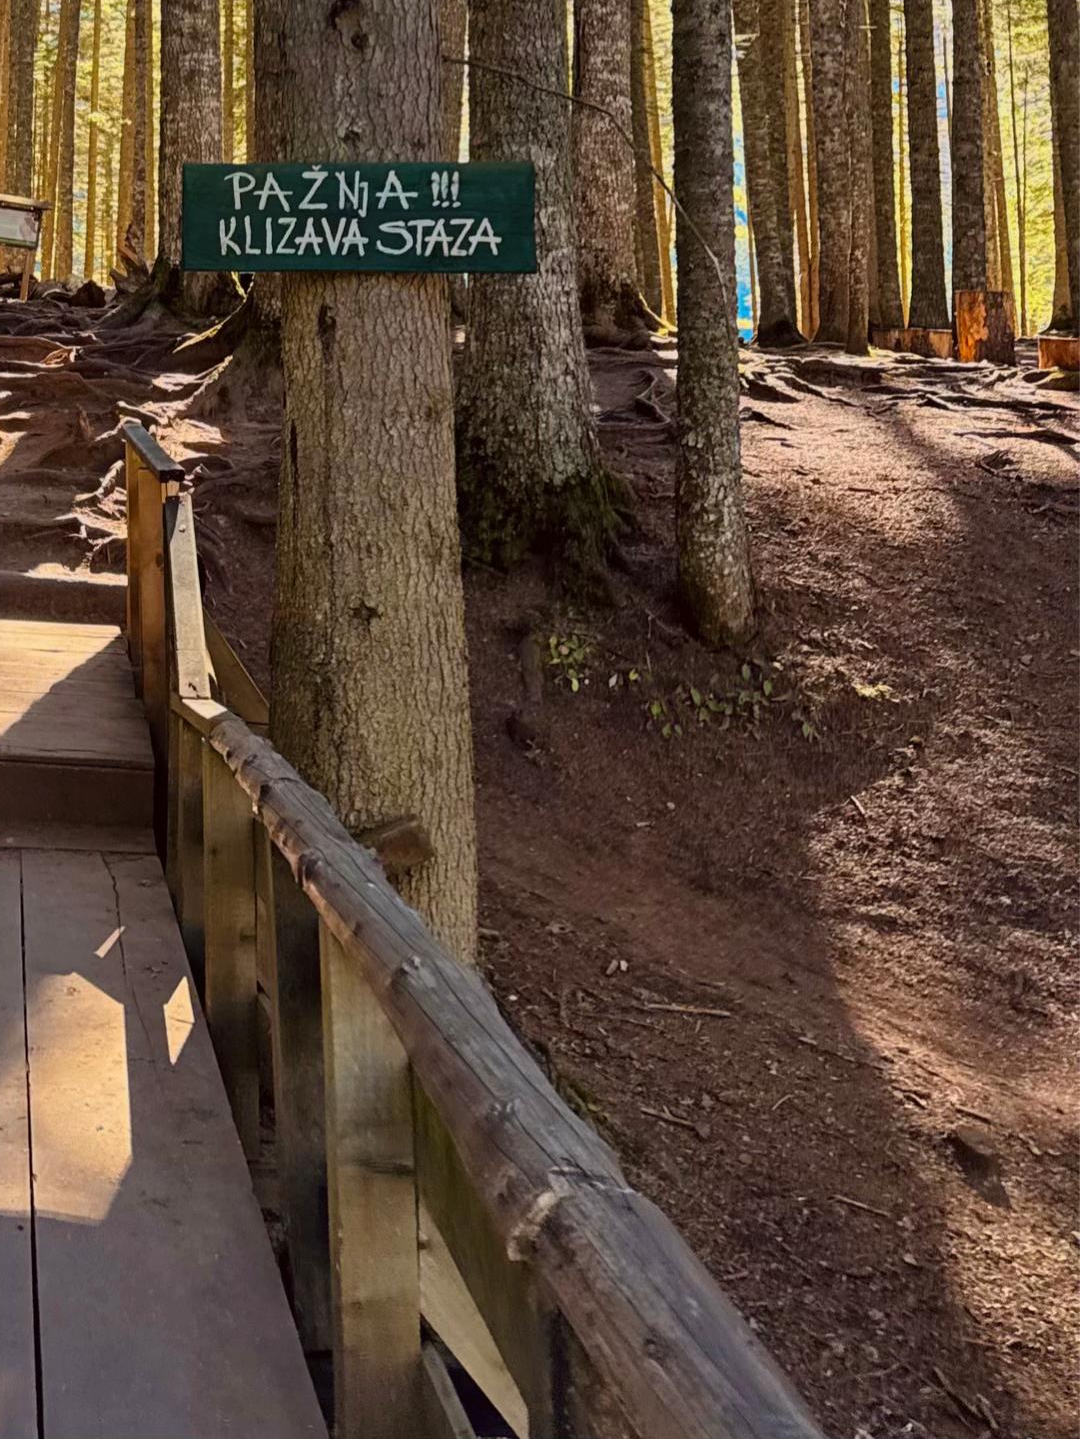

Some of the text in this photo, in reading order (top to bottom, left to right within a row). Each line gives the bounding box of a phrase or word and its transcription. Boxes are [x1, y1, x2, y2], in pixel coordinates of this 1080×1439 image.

[430, 170, 462, 209] !!!
[219, 215, 502, 257] KLIZAVA STAZA
